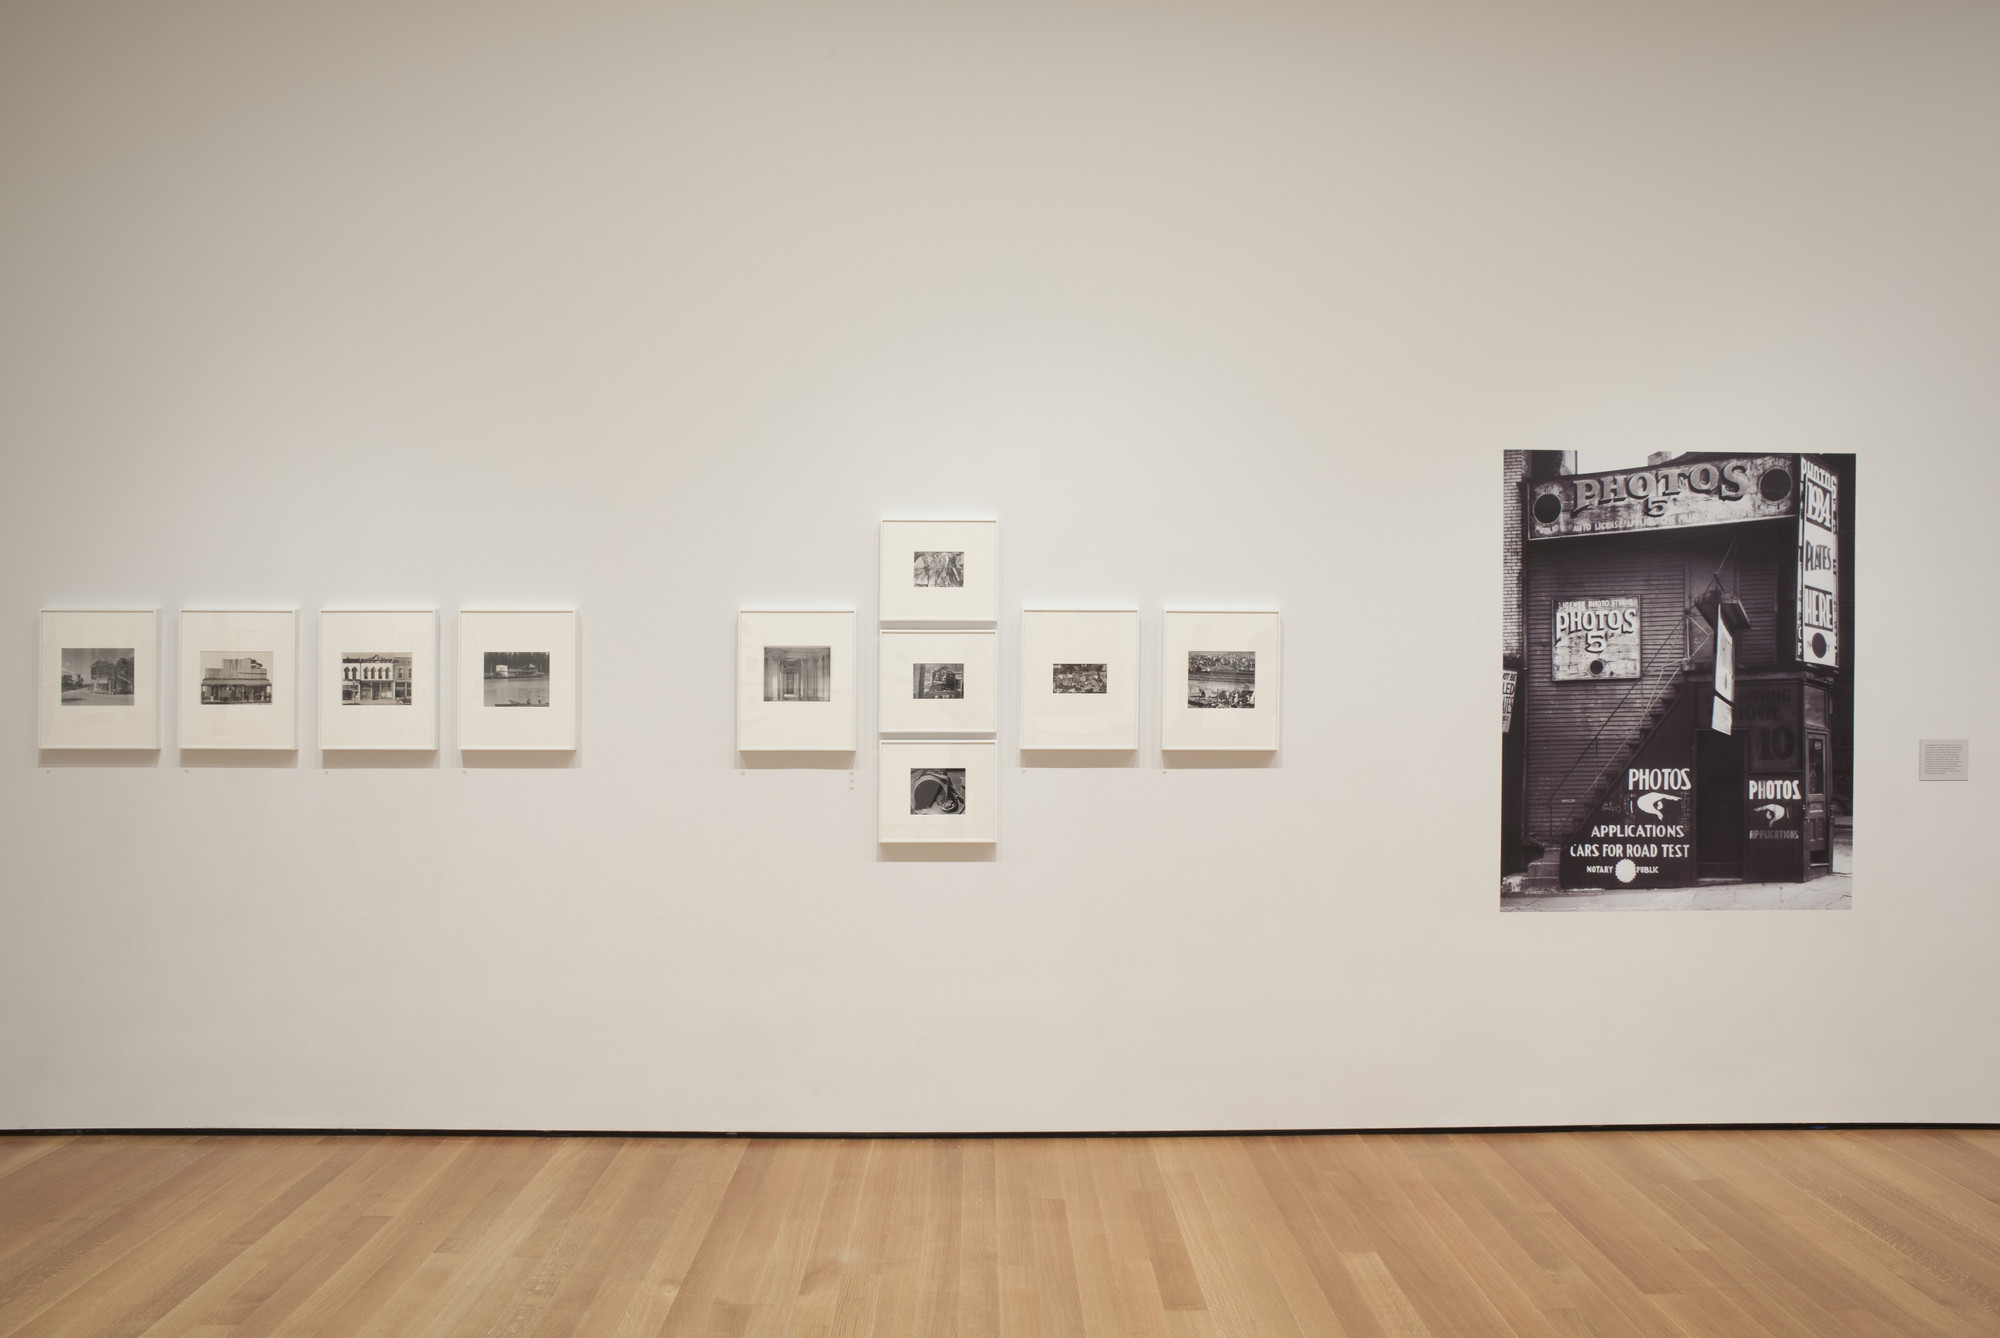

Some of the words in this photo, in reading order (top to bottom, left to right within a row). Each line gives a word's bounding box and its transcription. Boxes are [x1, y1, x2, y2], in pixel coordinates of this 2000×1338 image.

[1572, 460, 1749, 516] PHOTOS
[1800, 456, 1837, 499] PHOTOS
[1806, 482, 1832, 528] 1934
[1805, 540, 1832, 571] PLATES
[1804, 587, 1833, 630] HERE
[1555, 608, 1637, 645] PHOTOS
[1628, 768, 1691, 790] PHOTOS
[1749, 780, 1801, 800] PHOTOS
[1590, 825, 1684, 838] APPLICATIONS
[1749, 830, 1799, 840] APPLICATIONS
[1570, 844, 1599, 857] CARS
[1602, 844, 1623, 857] FOR
[1626, 844, 1658, 858] ROAD
[1661, 844, 1690, 858] TEST
